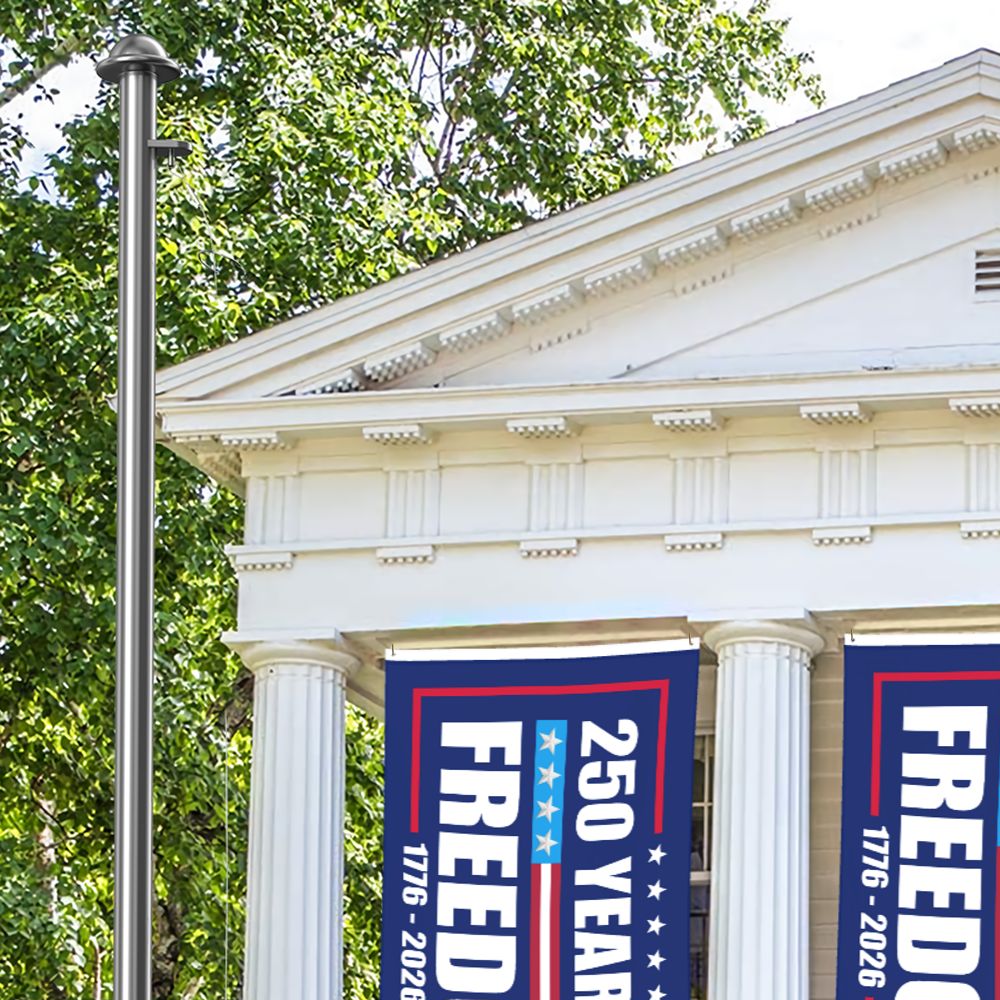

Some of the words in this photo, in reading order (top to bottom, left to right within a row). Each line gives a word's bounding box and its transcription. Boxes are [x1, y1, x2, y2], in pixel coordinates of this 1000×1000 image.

[574, 718, 639, 842] 250
[402, 843, 429, 906] 1776
[861, 825, 890, 889] 1776
[857, 912, 888, 988] 2026
